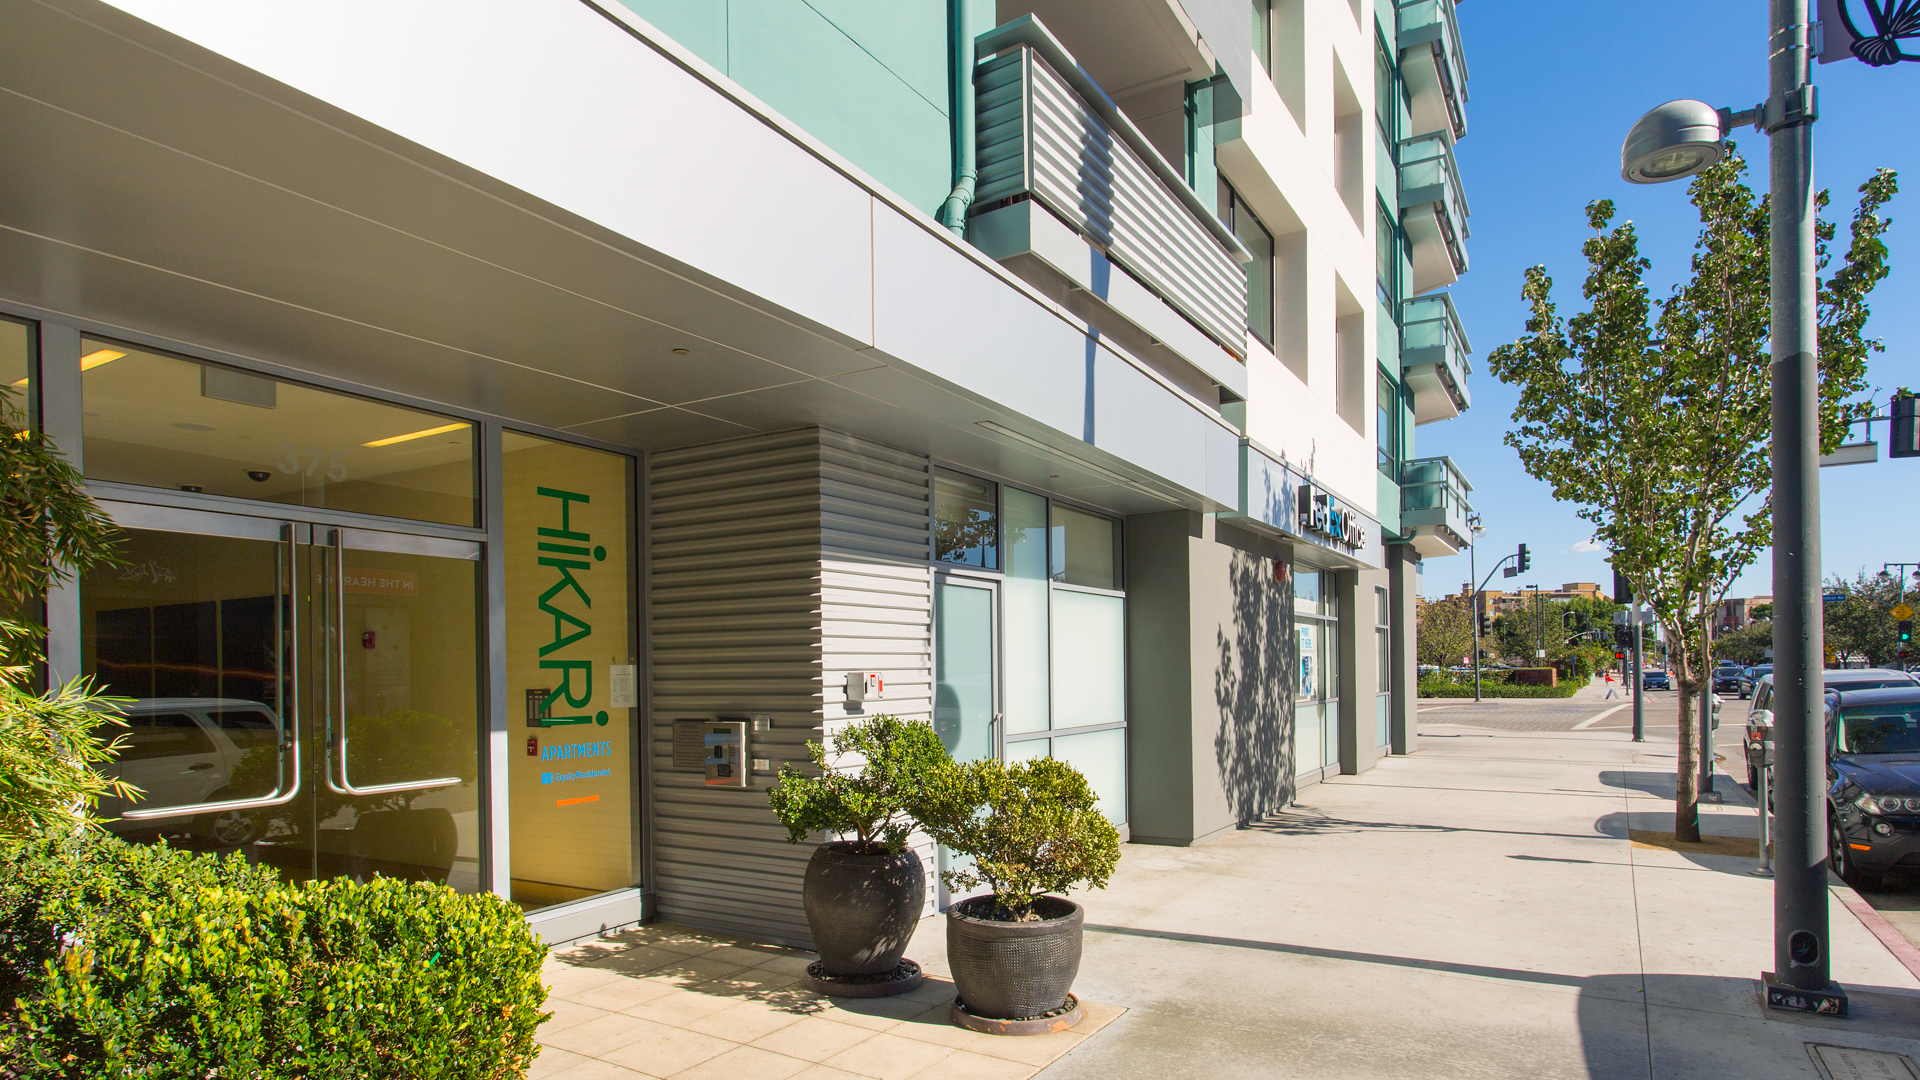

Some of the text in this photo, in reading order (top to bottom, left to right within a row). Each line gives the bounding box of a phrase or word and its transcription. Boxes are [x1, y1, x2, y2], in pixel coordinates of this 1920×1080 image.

[277, 443, 348, 482] 375
[541, 741, 611, 761] APARTMENTS
[555, 768, 611, 782] Equity Residential
